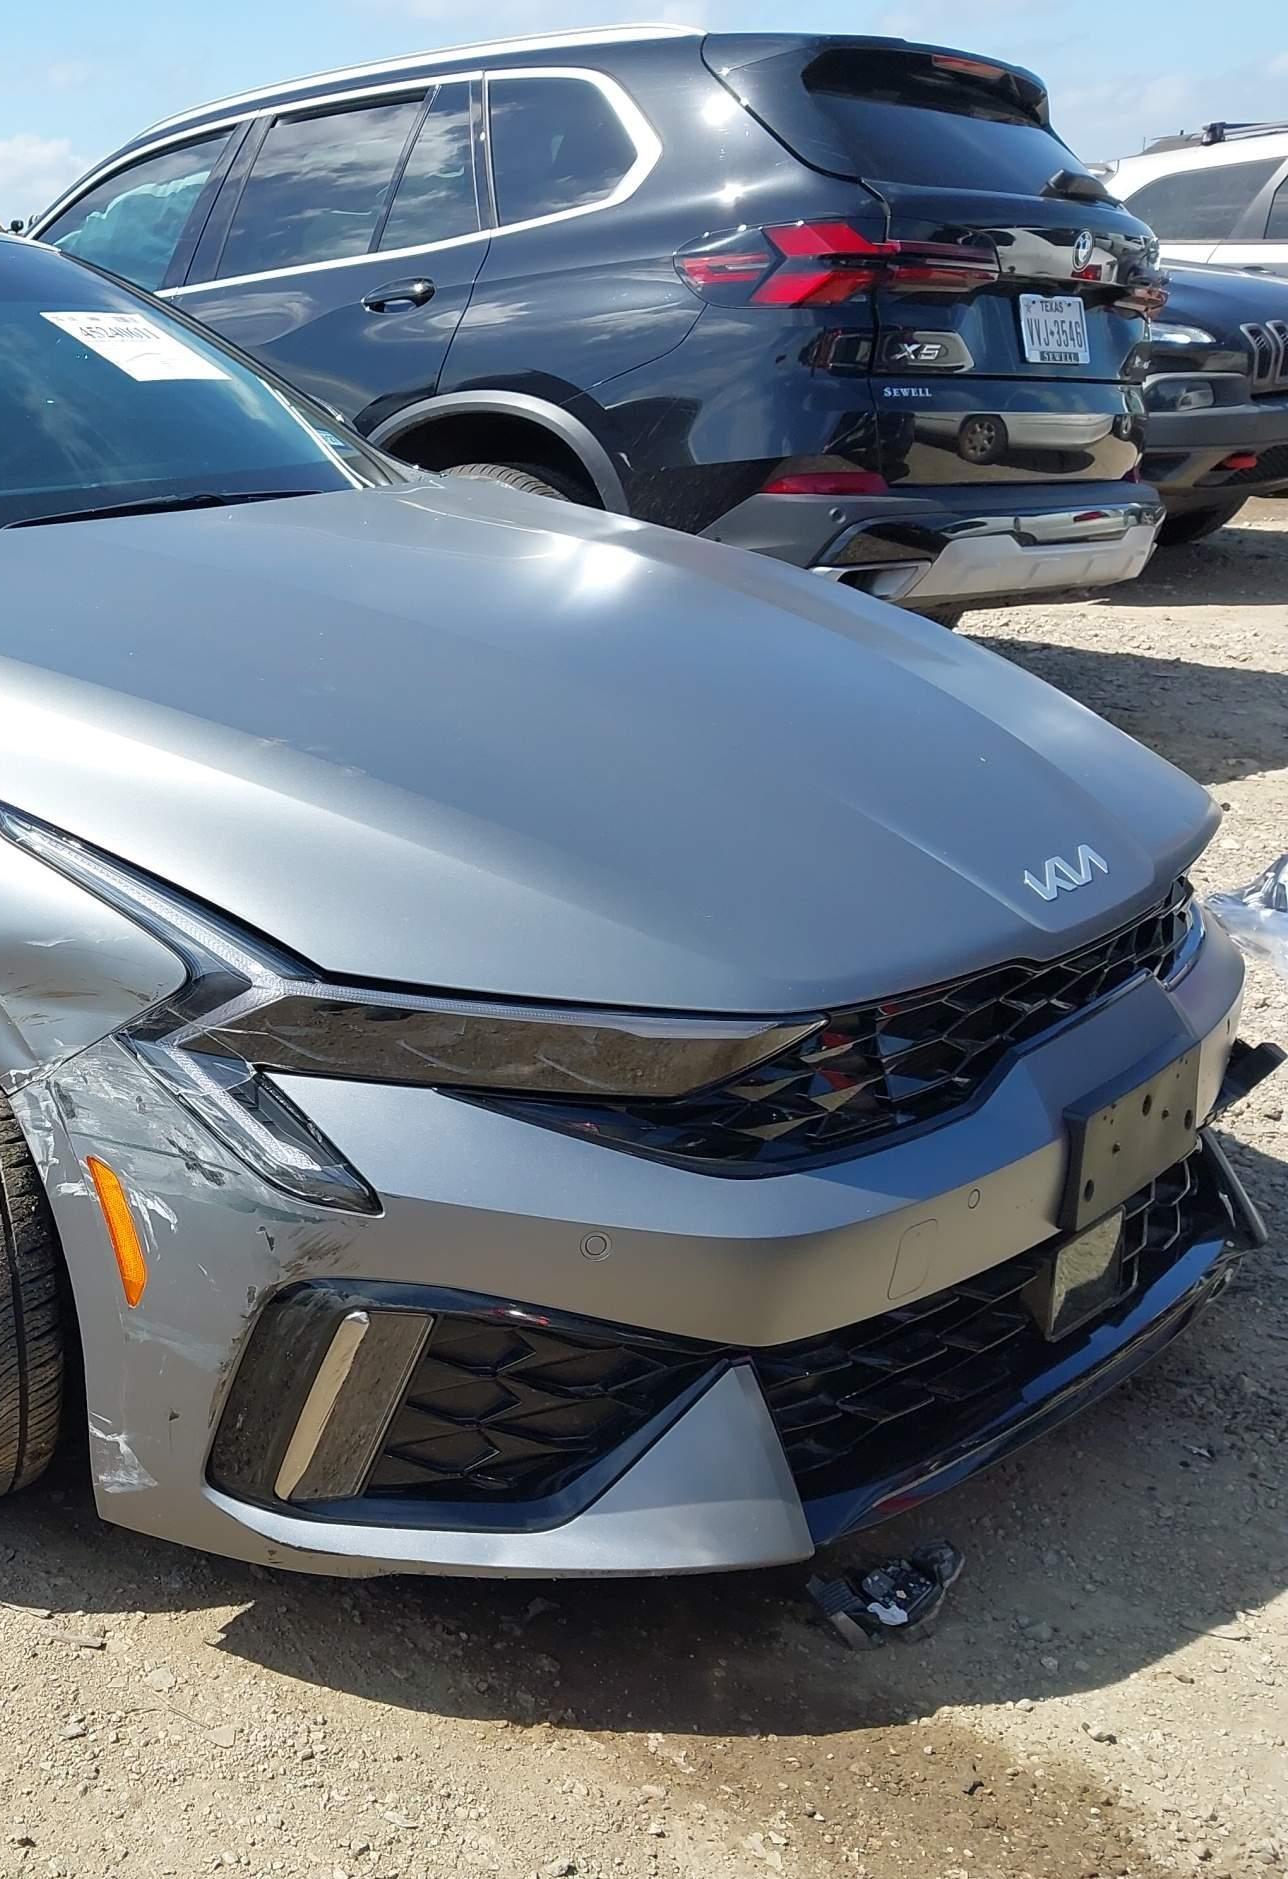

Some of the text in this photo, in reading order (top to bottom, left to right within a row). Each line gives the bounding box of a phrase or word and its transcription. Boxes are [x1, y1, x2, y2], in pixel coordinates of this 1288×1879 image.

[1039, 300, 1064, 313] TEXAS
[892, 343, 942, 360] X5
[883, 386, 932, 398] SEWELL
[1023, 844, 1109, 901] KIA
